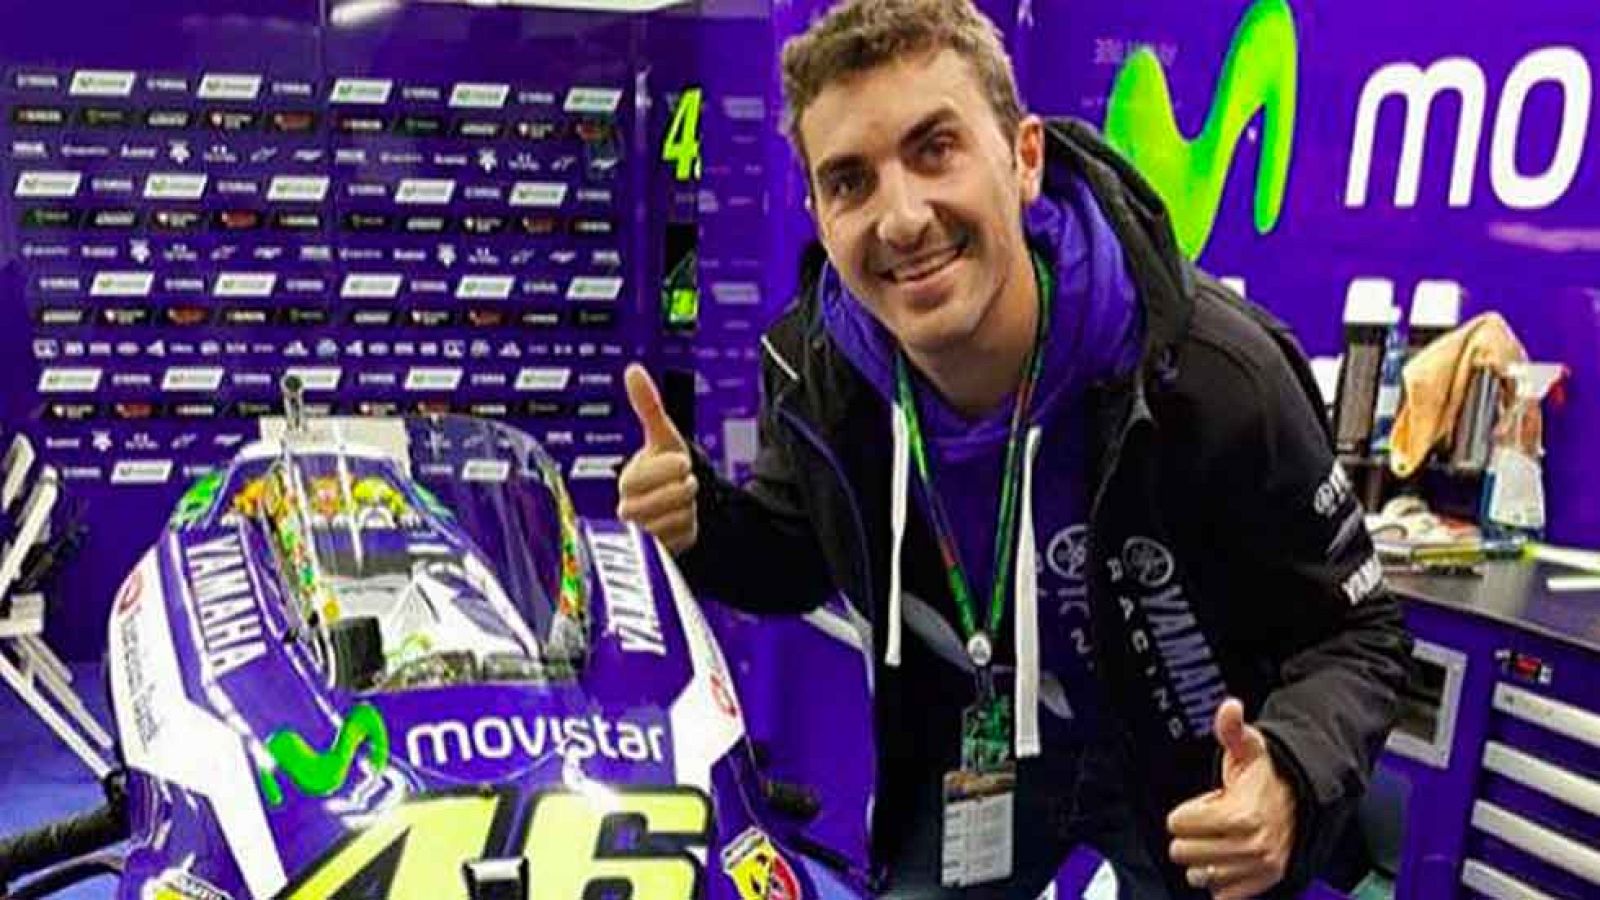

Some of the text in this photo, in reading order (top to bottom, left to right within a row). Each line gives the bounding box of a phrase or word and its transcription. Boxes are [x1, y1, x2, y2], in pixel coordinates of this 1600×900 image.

[662, 88, 702, 181] 4
[1345, 46, 1591, 209] mo
[185, 534, 267, 682] YAMAHA
[1106, 557, 1184, 739] RACING
[405, 714, 665, 769] movistar
[280, 790, 702, 900] 46
